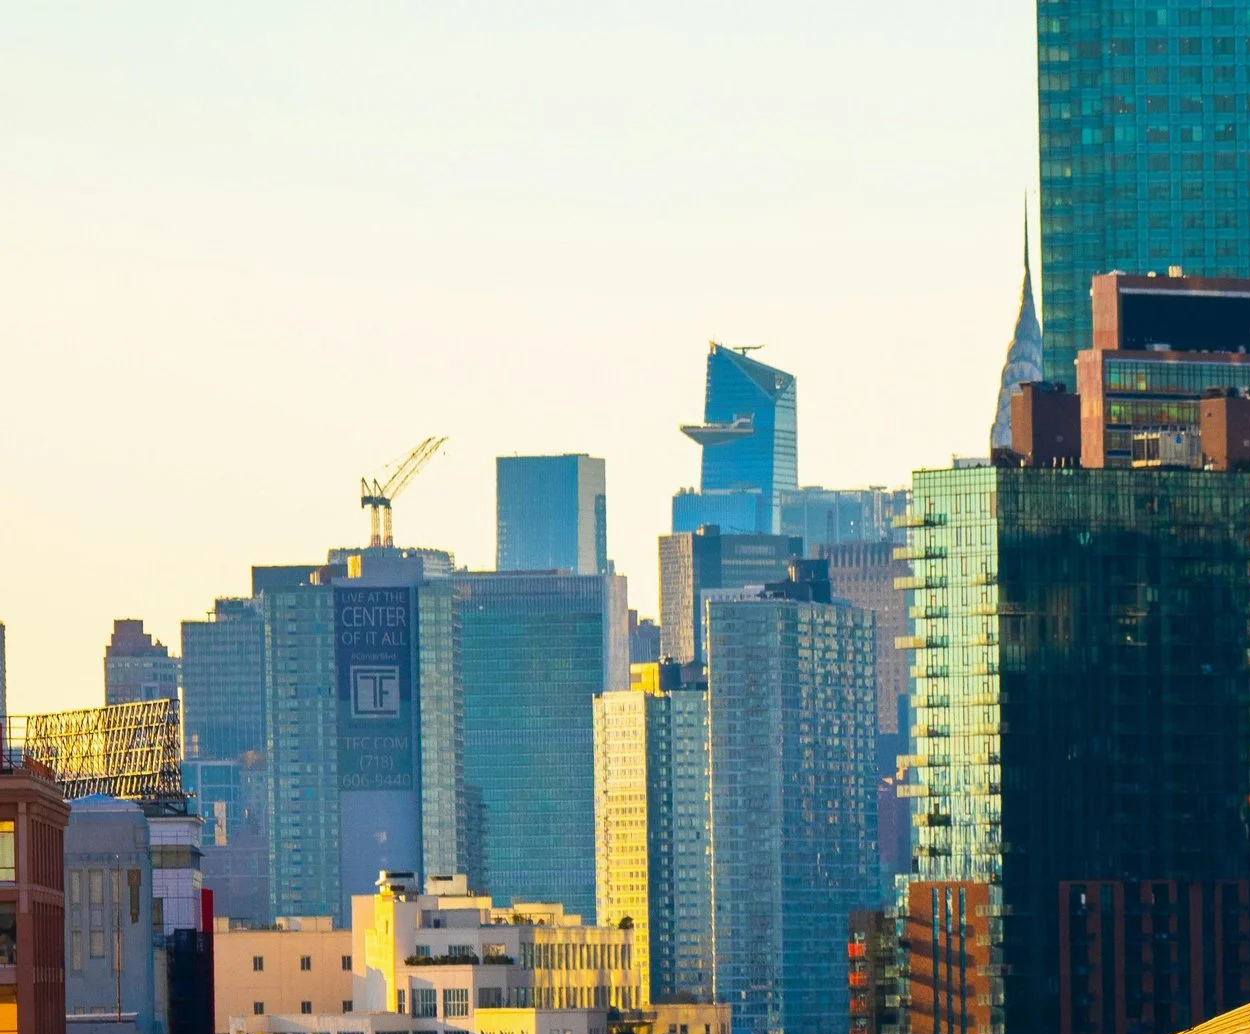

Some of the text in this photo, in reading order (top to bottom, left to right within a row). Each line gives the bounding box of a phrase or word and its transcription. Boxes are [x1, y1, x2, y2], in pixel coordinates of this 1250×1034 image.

[342, 592, 406, 603] LIVE AT THE
[341, 606, 406, 627] CENTER
[341, 632, 406, 645] OF IT ALL
[360, 754, 393, 771] (718)
